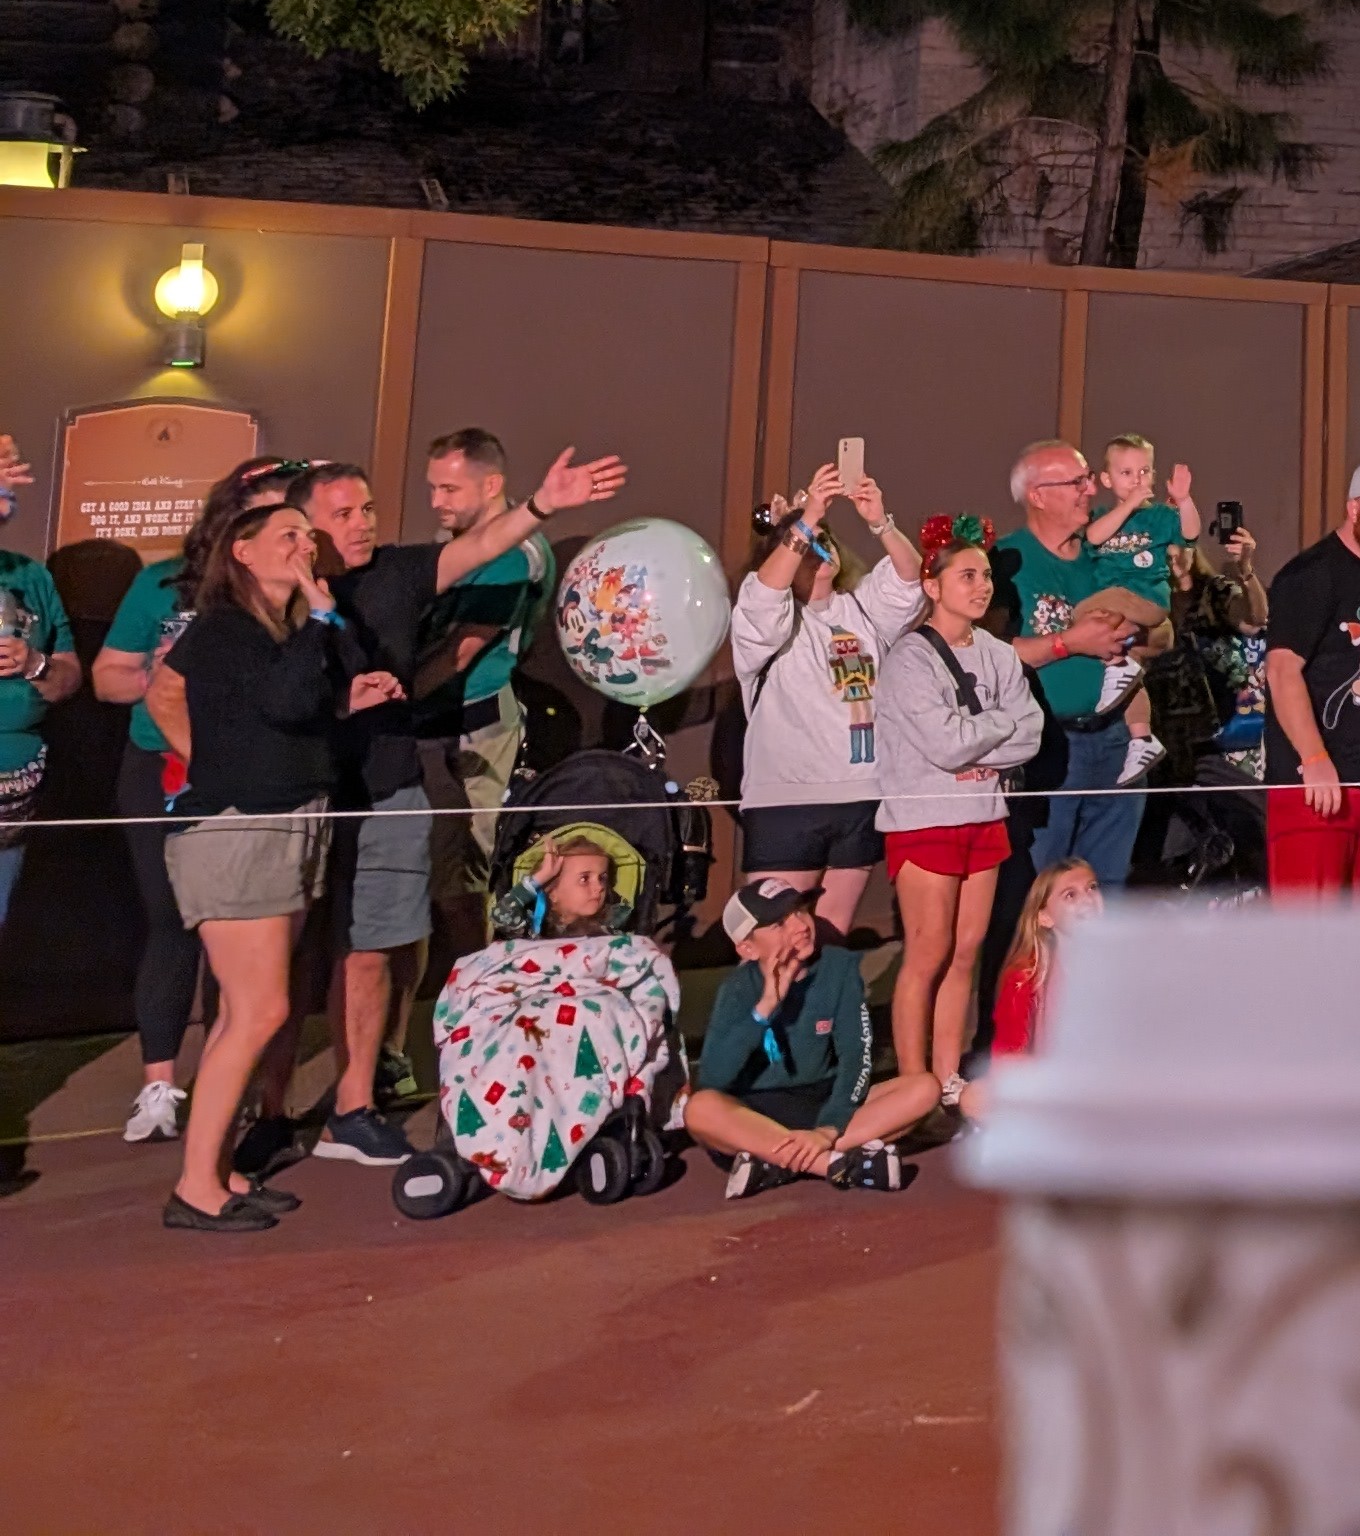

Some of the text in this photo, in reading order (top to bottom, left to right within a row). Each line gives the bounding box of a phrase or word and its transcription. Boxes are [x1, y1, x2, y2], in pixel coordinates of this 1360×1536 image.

[99, 501, 106, 512] A
[154, 500, 172, 510] AND
[123, 514, 141, 524] AND
[144, 513, 170, 524] WORK
[171, 512, 182, 523] AT
[141, 526, 159, 536] AND
